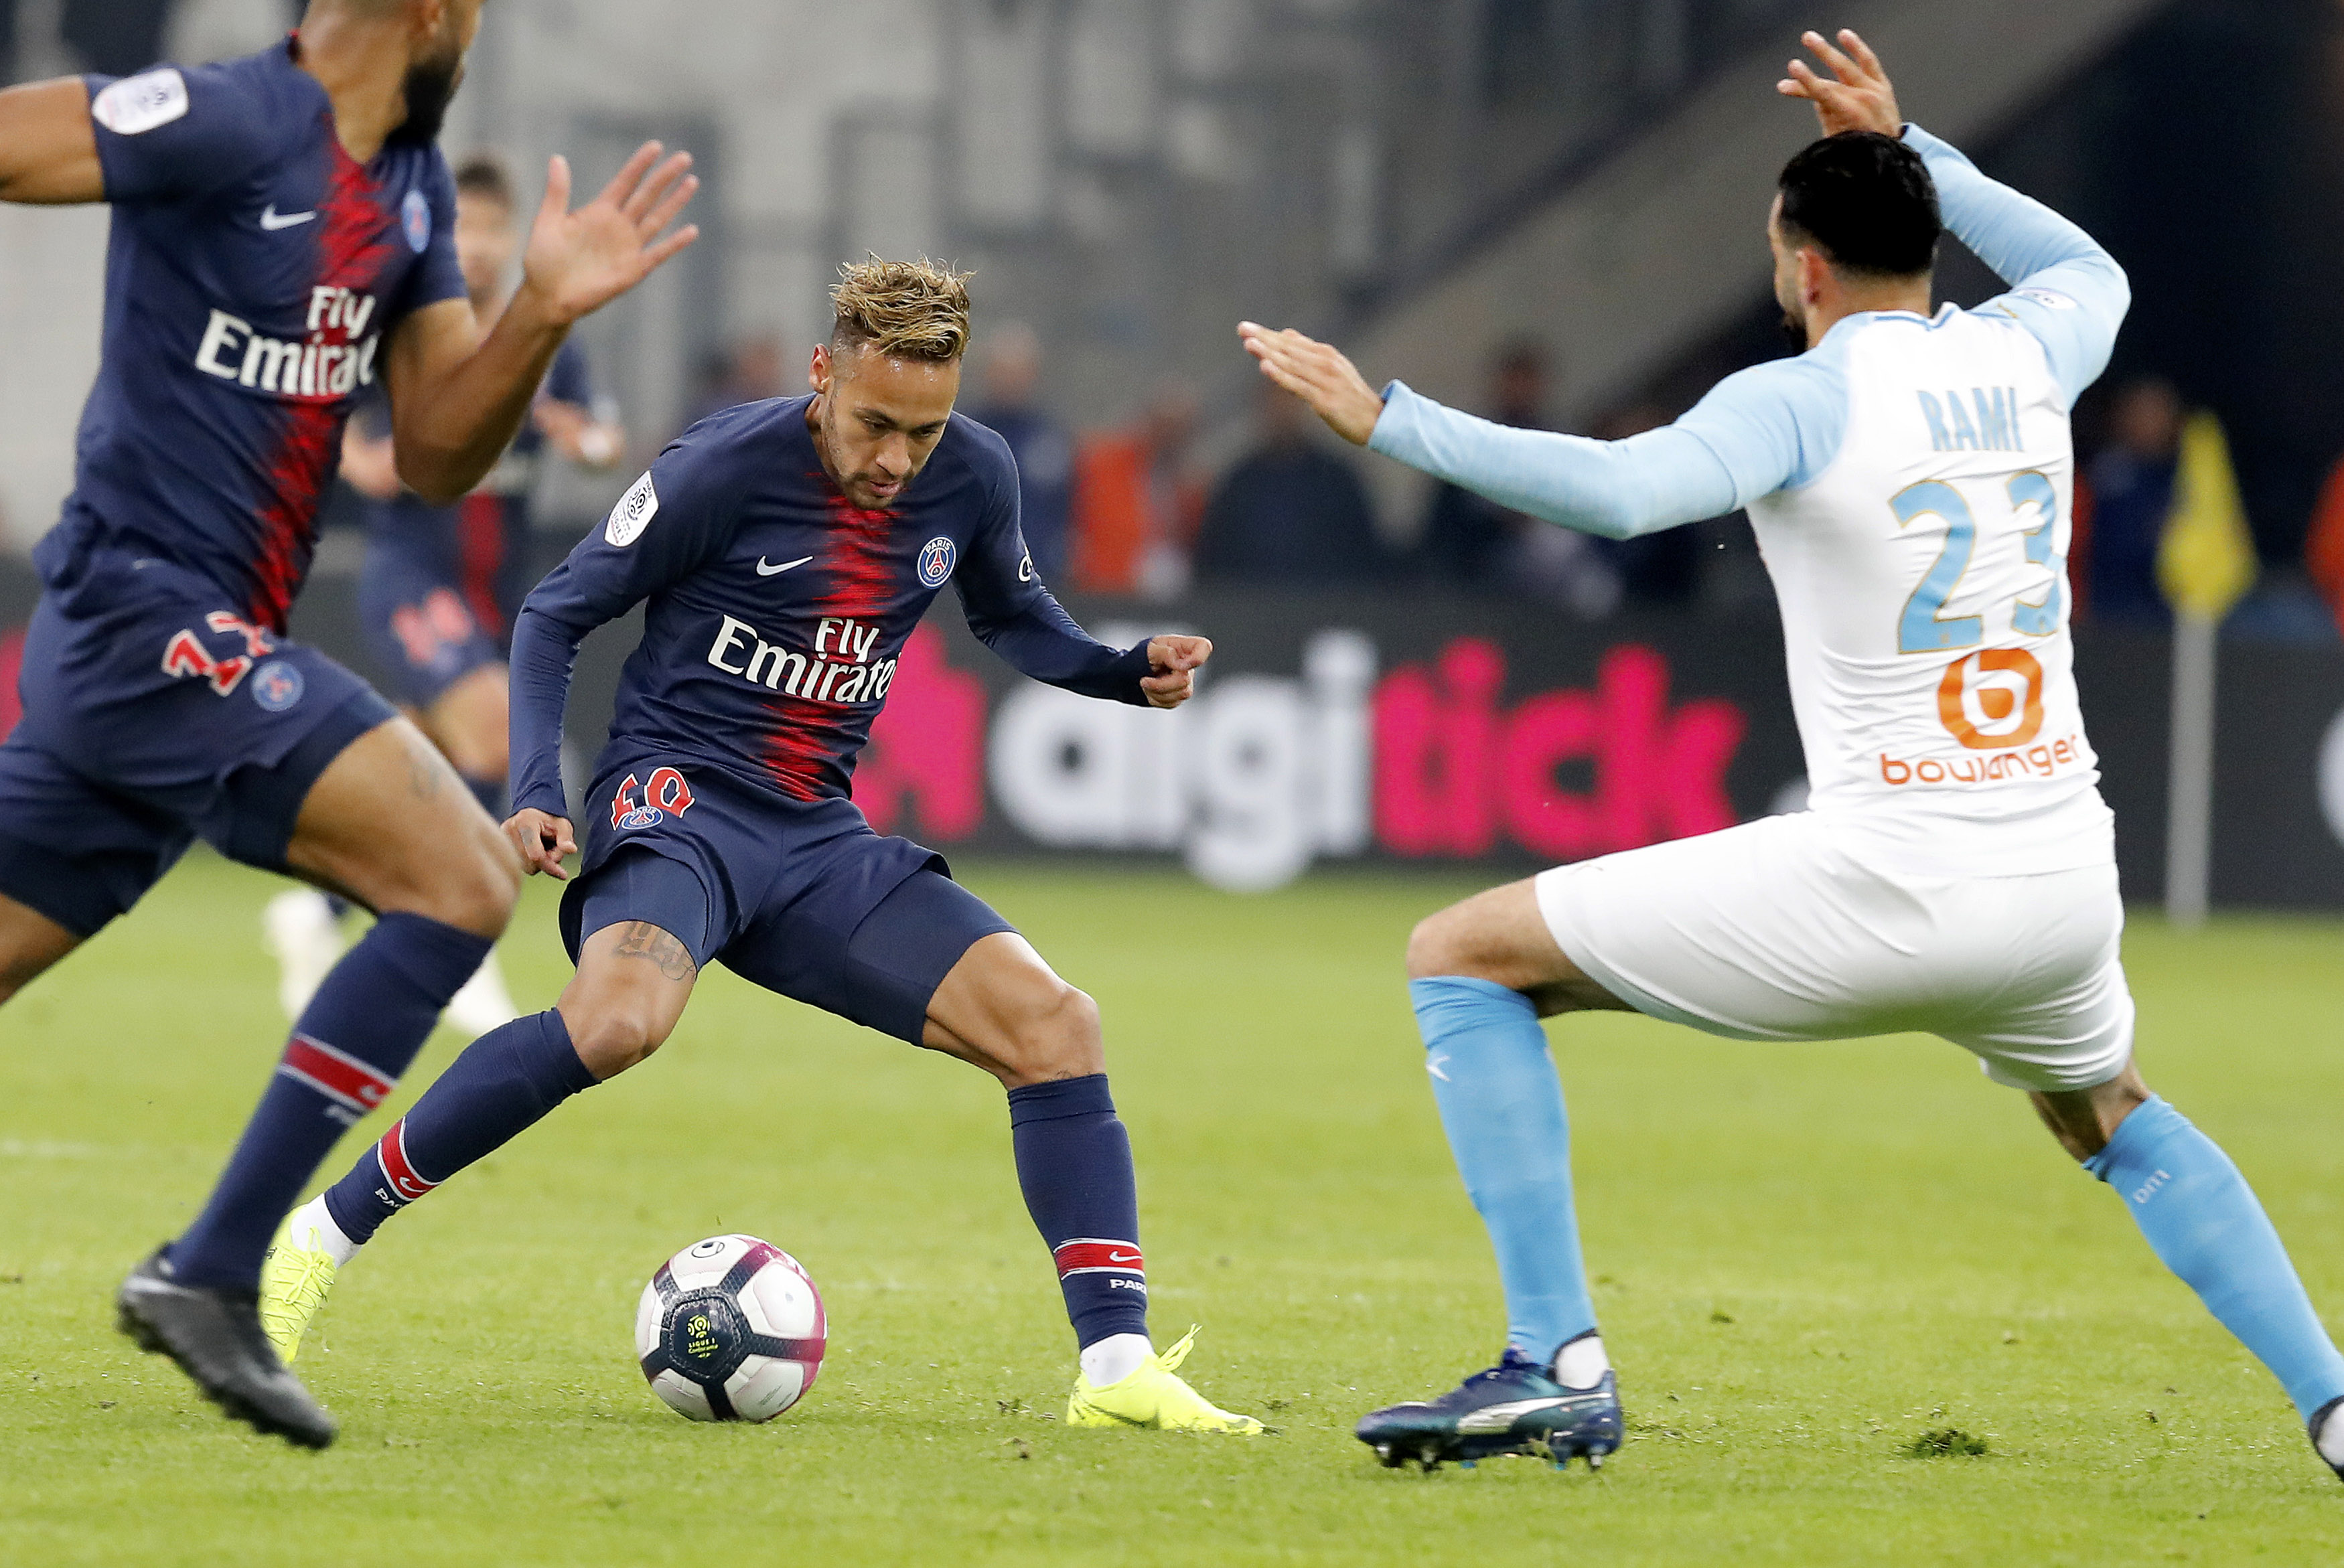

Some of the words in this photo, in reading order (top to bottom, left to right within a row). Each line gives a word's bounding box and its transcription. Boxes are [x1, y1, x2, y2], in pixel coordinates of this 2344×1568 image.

[305, 285, 376, 338] Fly
[1915, 386, 2026, 452] RAMI
[925, 540, 951, 554] PARIS
[1887, 469, 2063, 655] 23
[708, 614, 901, 703] Emirate
[814, 617, 879, 663] Fly
